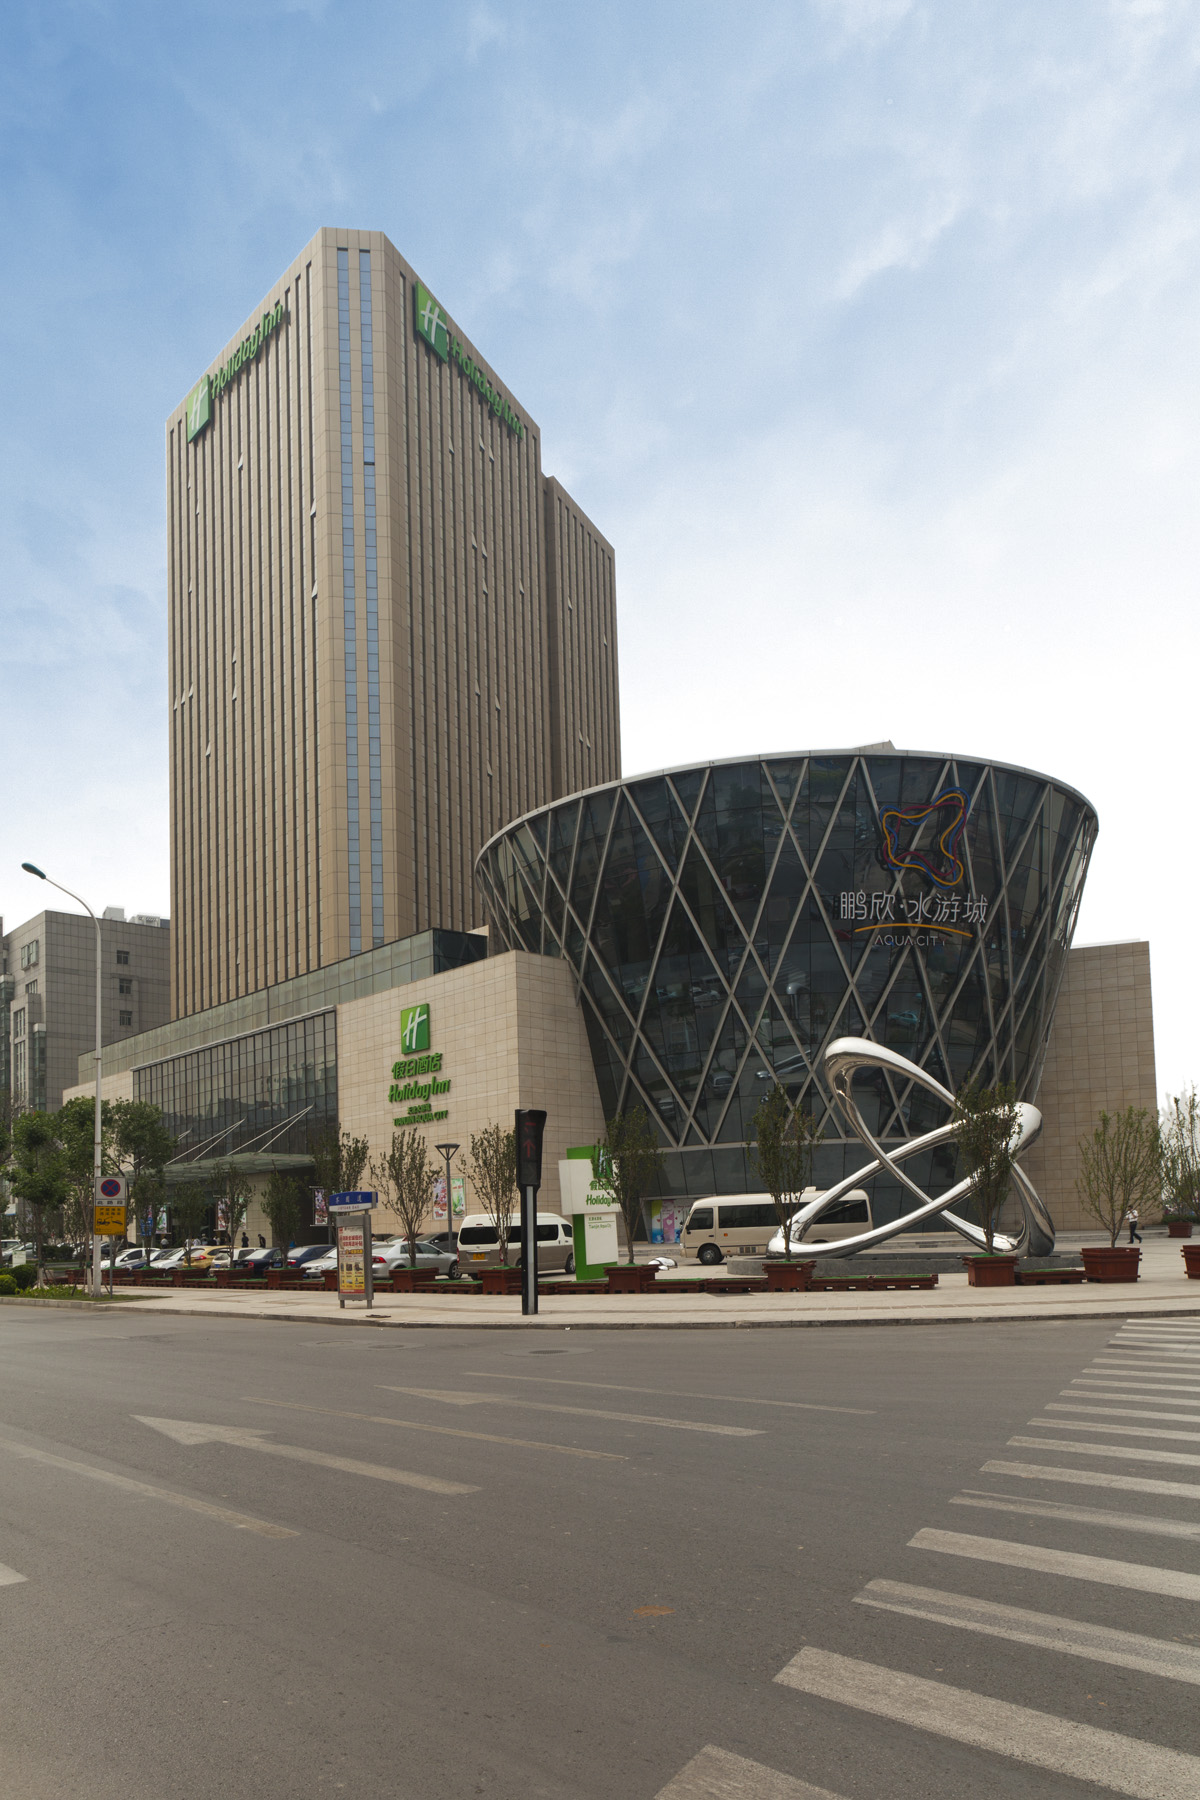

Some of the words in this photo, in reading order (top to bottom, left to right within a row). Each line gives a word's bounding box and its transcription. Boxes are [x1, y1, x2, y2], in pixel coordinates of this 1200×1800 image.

[211, 329, 260, 400] Holiday
[261, 304, 283, 341] Inn
[451, 336, 503, 416] Holiday
[503, 400, 524, 440] Inn
[874, 934, 914, 946] AQUA
[916, 935, 949, 946] CITY
[391, 1053, 443, 1080] 假日酒店
[388, 1081, 431, 1102] Holiday
[431, 1076, 450, 1095] Inn
[433, 1110, 449, 1121] CITY
[586, 1194, 611, 1207] Holiday
